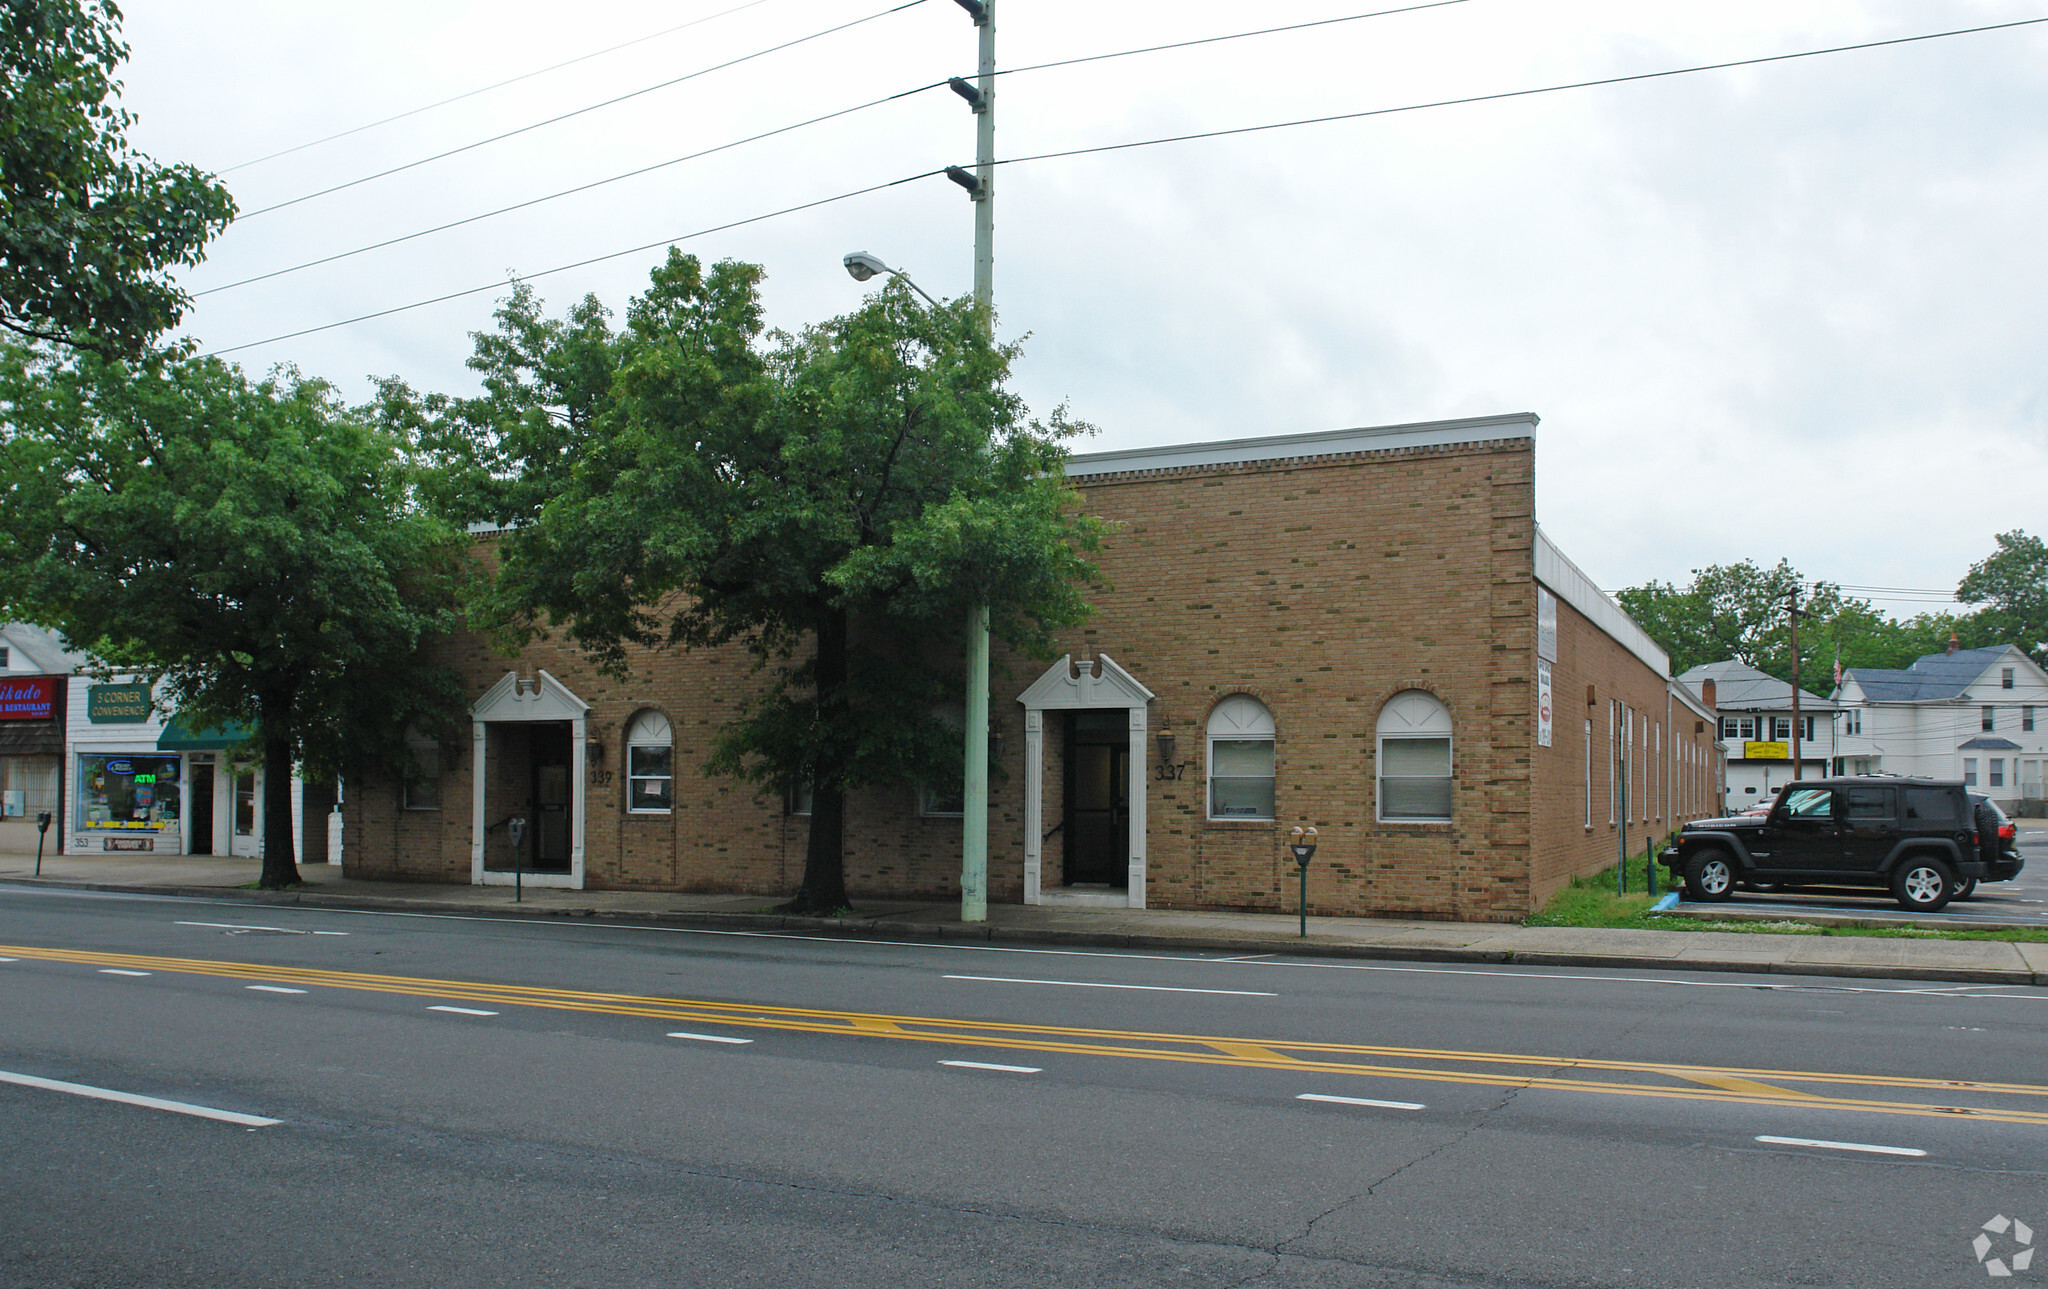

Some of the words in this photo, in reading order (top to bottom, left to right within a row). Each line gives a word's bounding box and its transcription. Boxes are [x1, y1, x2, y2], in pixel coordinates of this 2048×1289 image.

[0, 684, 41, 700] ikado
[104, 691, 141, 703] CORNER
[5, 703, 51, 712] RESTAURANT
[92, 705, 145, 717] CONVENIENCE
[590, 770, 612, 784] 339
[1155, 764, 1185, 781] 337
[134, 774, 156, 784] ATM
[75, 837, 89, 848] 353
